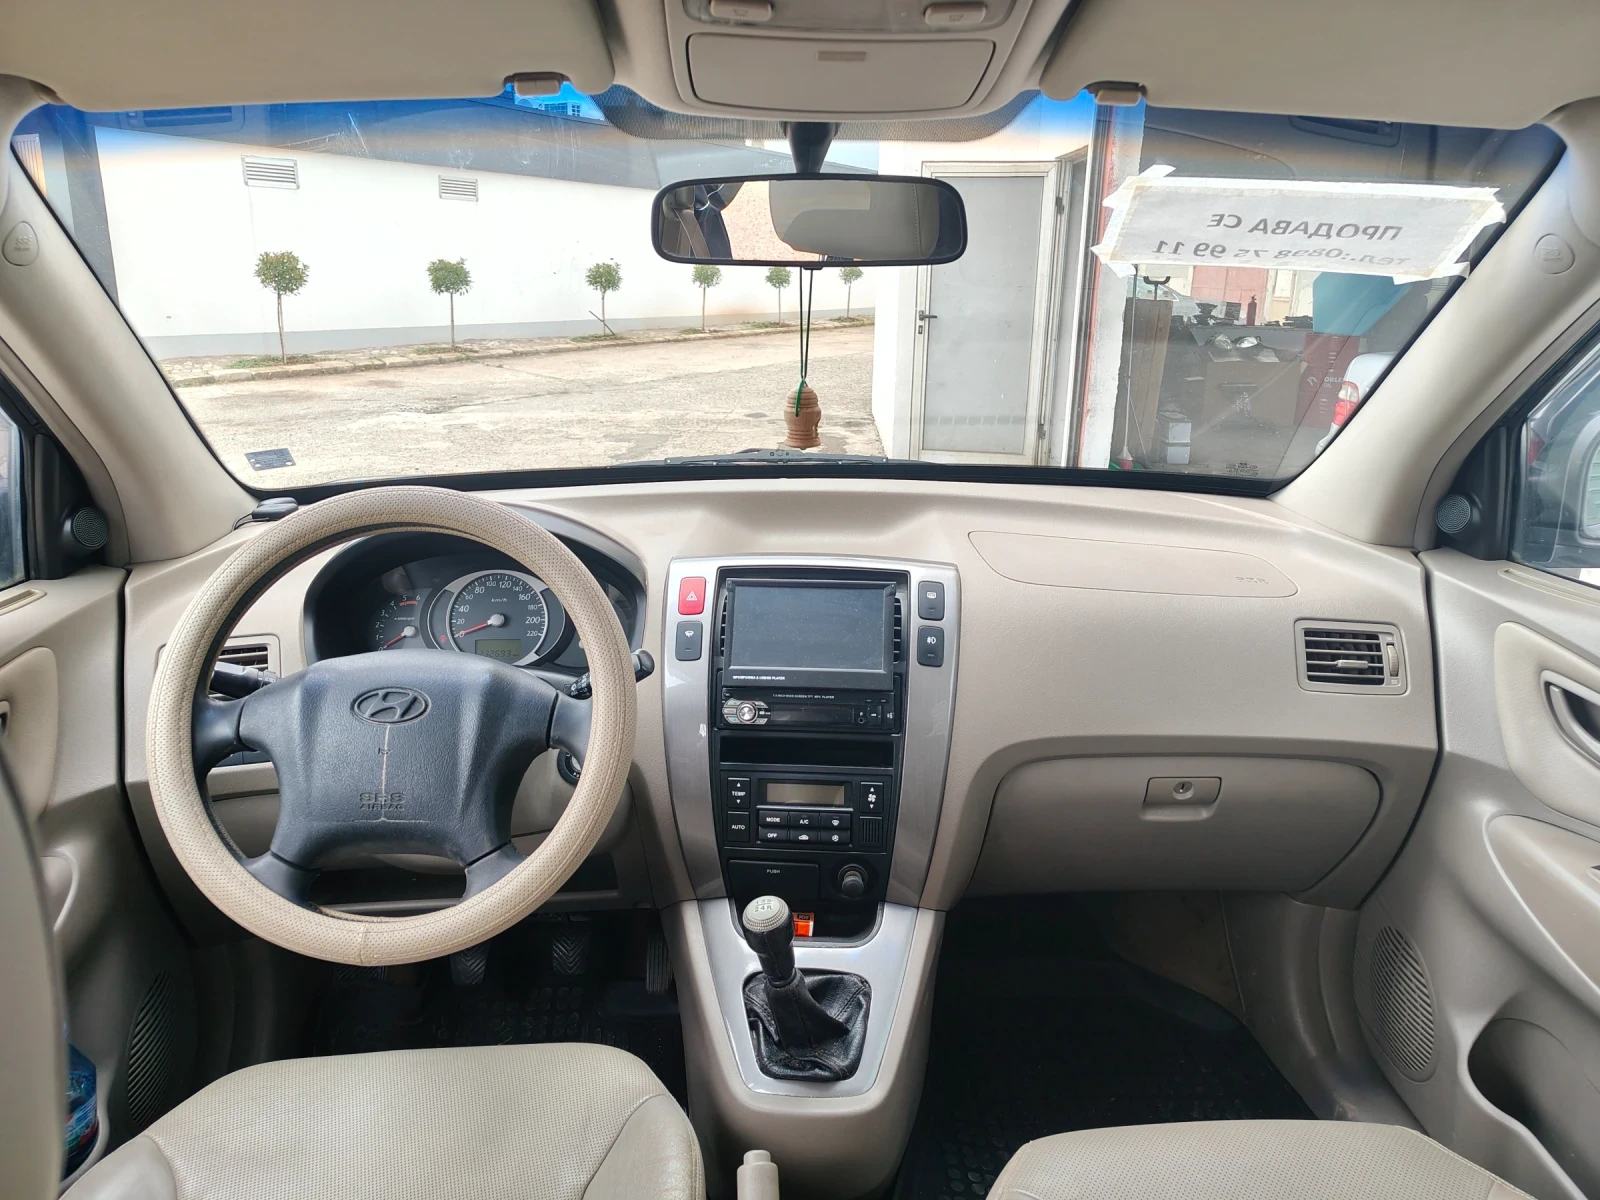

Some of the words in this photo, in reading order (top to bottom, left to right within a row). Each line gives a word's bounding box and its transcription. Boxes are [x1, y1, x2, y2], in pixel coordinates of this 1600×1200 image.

[474, 586, 485, 594] 80
[525, 616, 541, 624] 200
[359, 792, 405, 804] SRS
